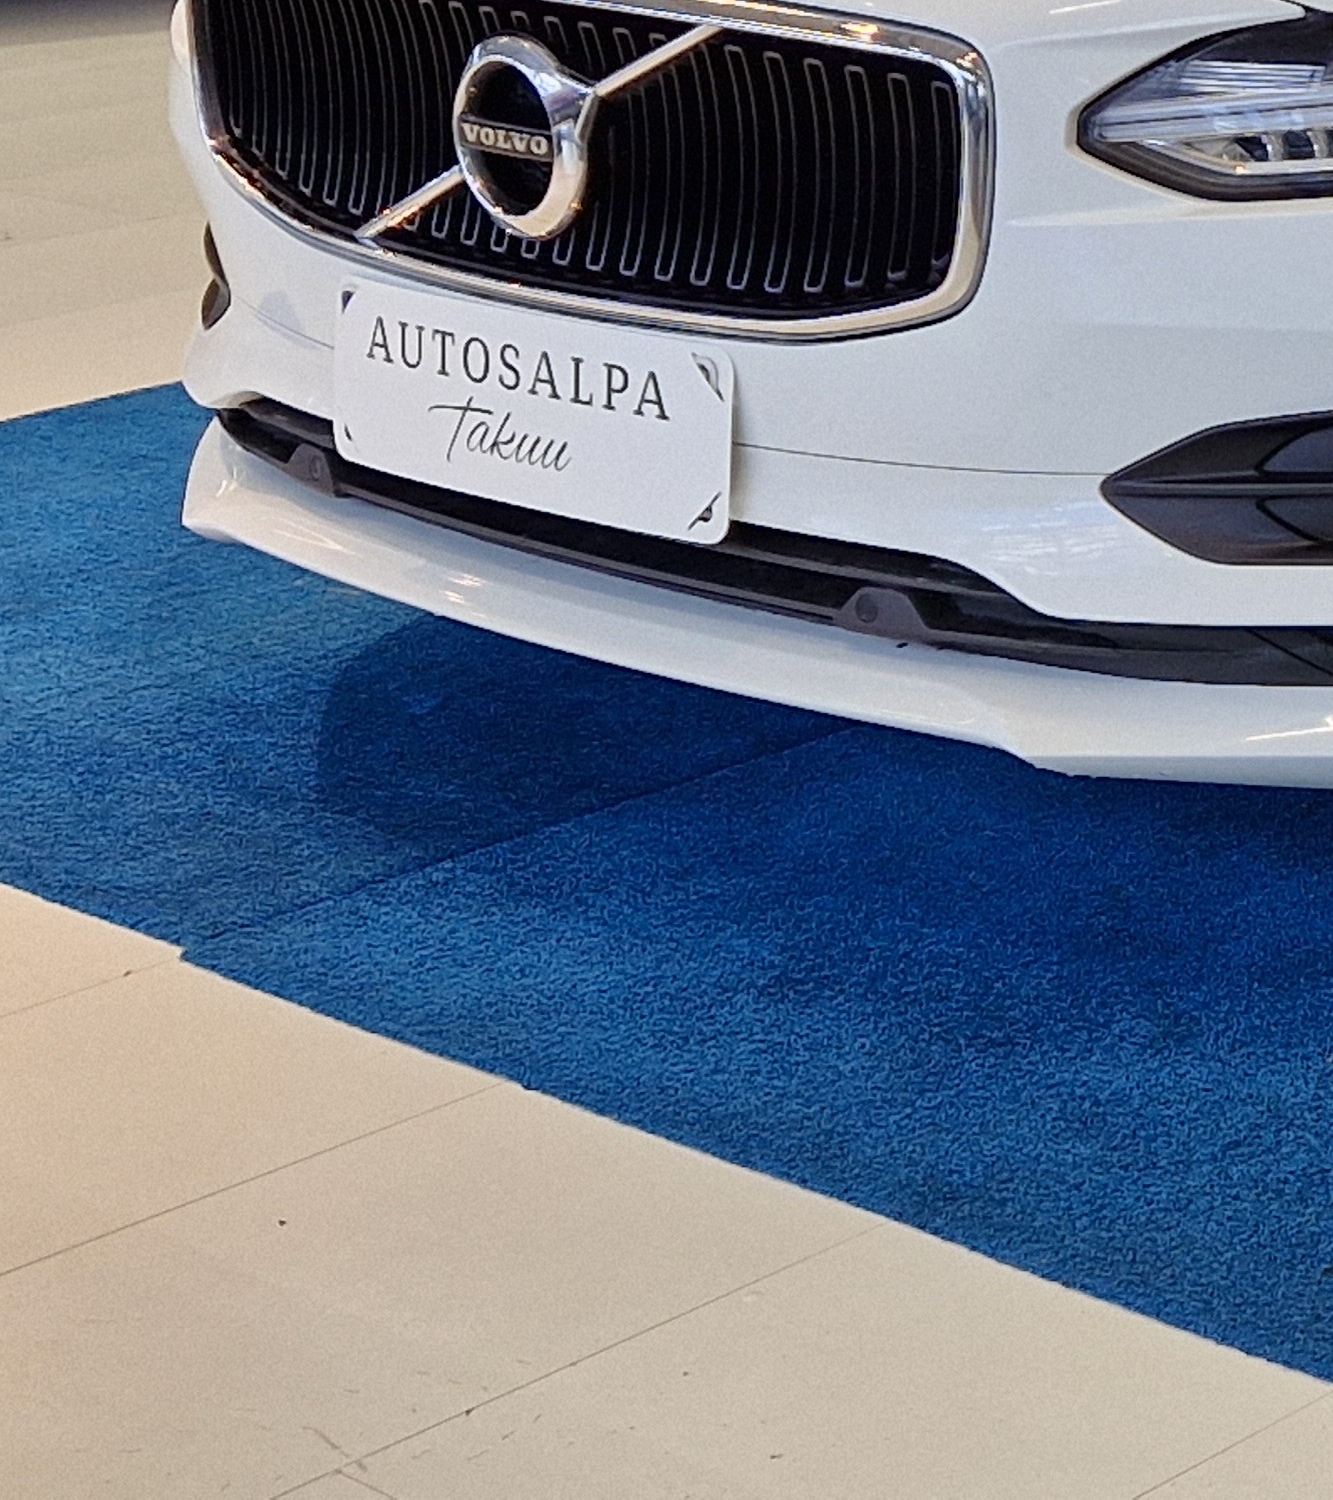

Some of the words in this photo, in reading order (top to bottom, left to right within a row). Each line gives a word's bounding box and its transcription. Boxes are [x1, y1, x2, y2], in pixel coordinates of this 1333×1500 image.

[460, 121, 549, 156] VOLVO
[366, 315, 671, 421] AUTOSALPA
[428, 395, 572, 472] Takuu
